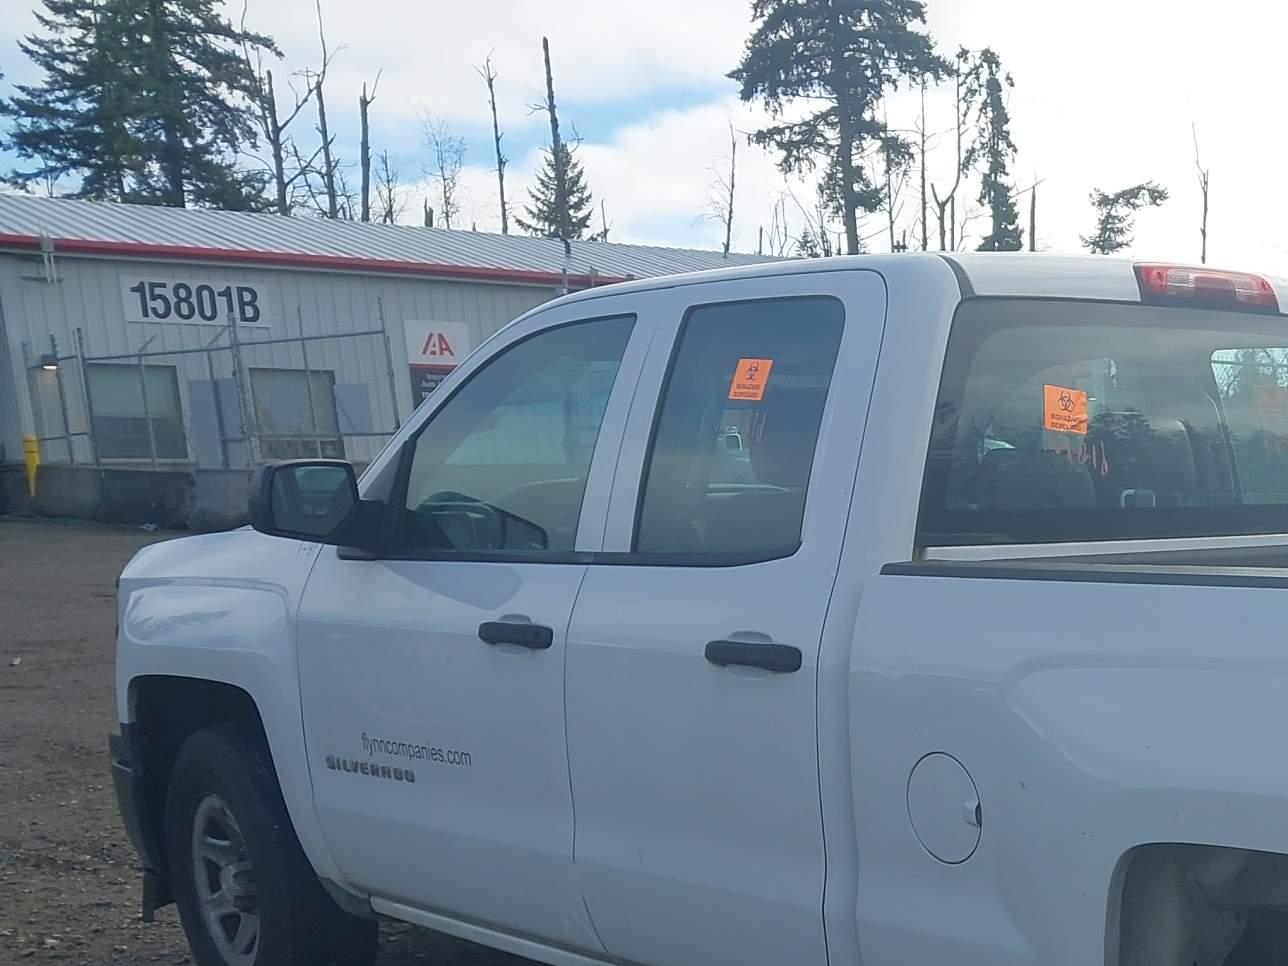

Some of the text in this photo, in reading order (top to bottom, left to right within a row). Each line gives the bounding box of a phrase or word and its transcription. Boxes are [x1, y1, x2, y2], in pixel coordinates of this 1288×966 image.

[130, 281, 261, 323] 15801B
[361, 732, 472, 767] flynncompanies.com
[325, 754, 416, 783] SILVERADO
